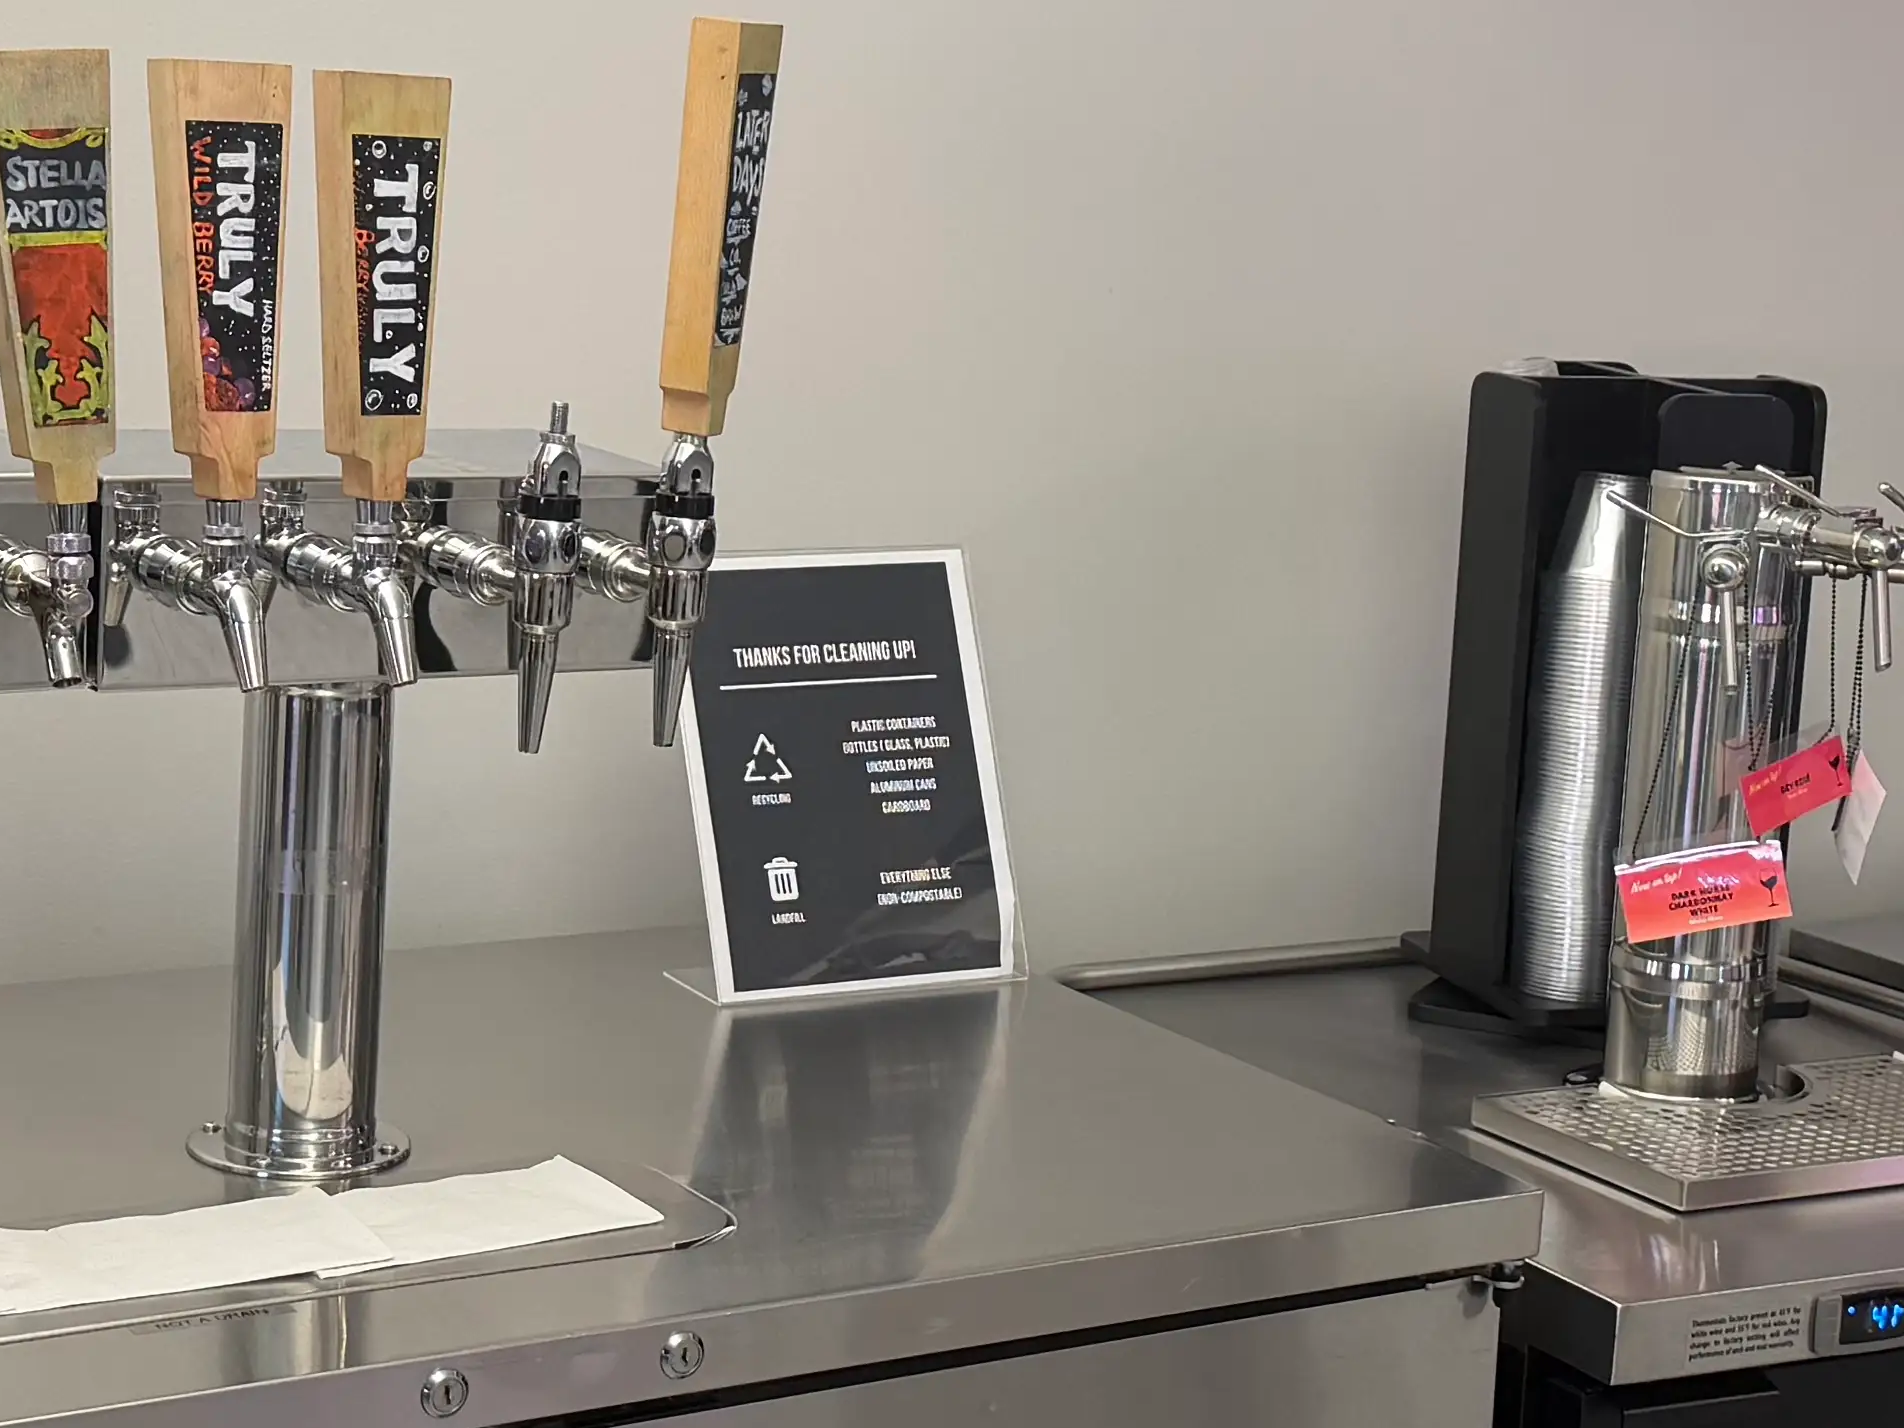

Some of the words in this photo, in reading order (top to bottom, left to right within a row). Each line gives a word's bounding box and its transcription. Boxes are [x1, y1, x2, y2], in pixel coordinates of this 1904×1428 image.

[736, 109, 771, 155] LATER
[6, 155, 108, 192] STELLA
[192, 136, 214, 207] WILD
[732, 154, 765, 206] DAYS
[5, 197, 106, 230] ARTOIS
[212, 140, 256, 317] TRULY
[193, 222, 215, 294] BERRY
[369, 164, 419, 383] TRULY
[262, 299, 274, 334] HARD
[261, 336, 274, 391] SELTZER
[732, 646, 791, 668] THANKS
[793, 644, 821, 665] FOR
[823, 641, 890, 663] CLEANING
[892, 640, 917, 660] UP!
[851, 719, 885, 732] PLASTIC
[886, 716, 936, 730] CONTAINERS
[842, 740, 878, 753] BOTTLES
[907, 757, 934, 770] PAPER
[751, 793, 792, 806] RECYCLING
[914, 777, 937, 790] CANS
[881, 798, 931, 813] CARDBOARD
[931, 866, 952, 881] ELSE
[771, 912, 807, 925] LANDFILL
